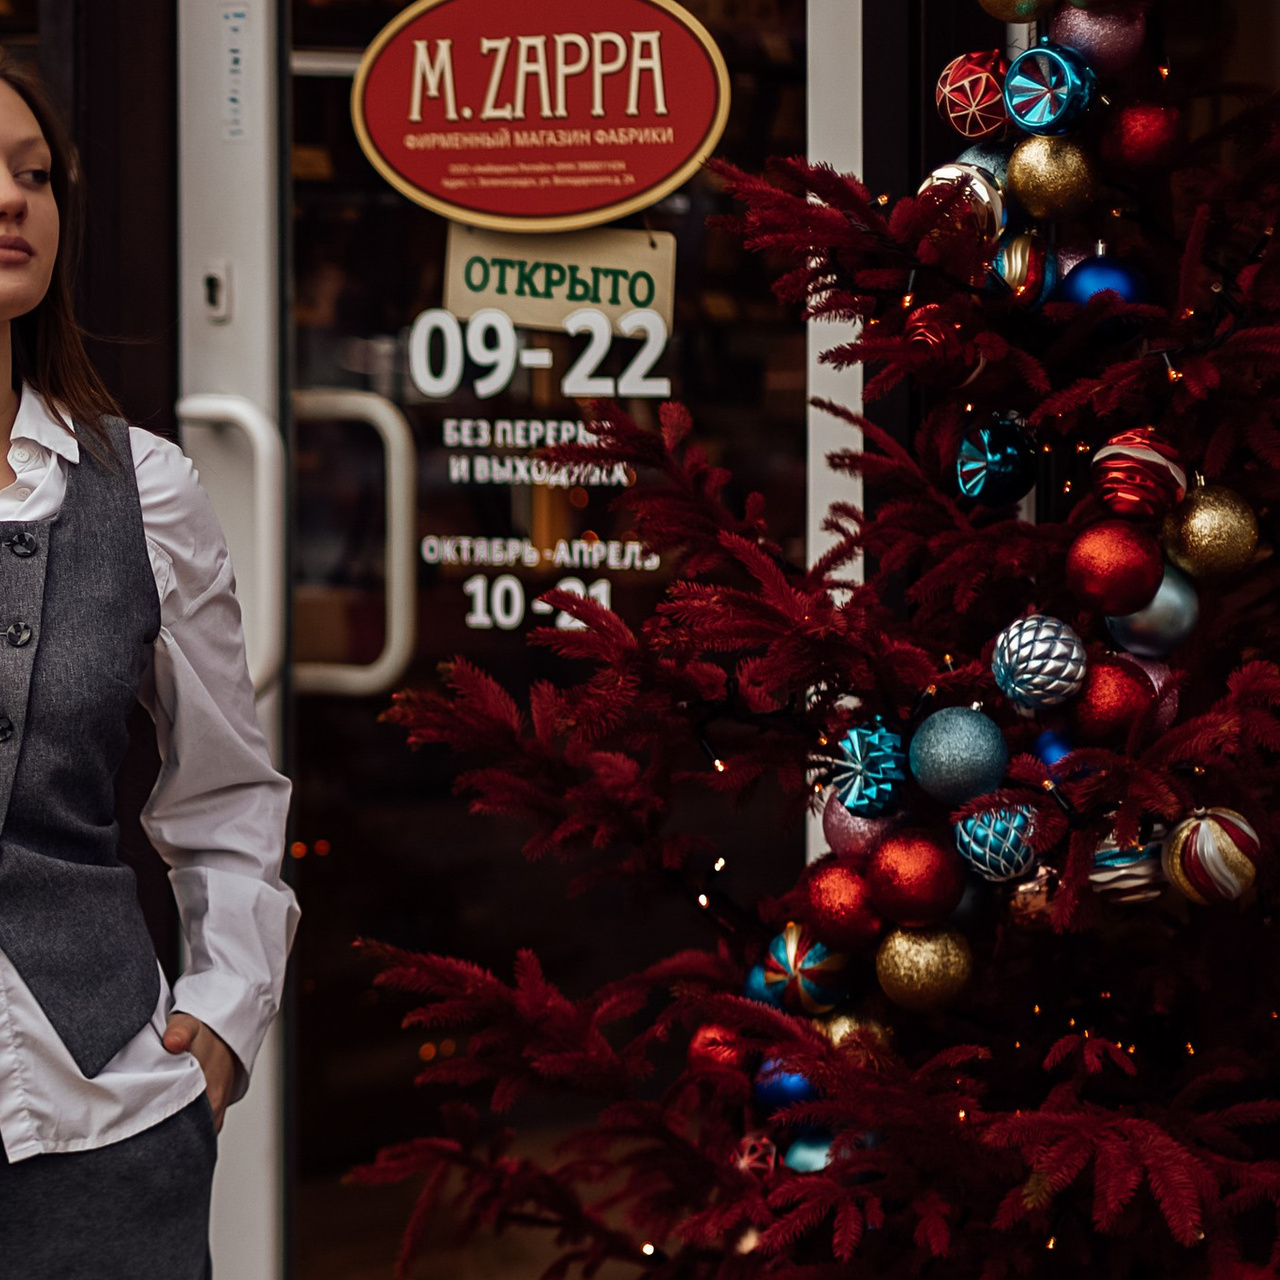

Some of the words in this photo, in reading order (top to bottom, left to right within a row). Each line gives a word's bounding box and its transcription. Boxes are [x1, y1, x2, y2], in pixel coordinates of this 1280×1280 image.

[408, 38, 472, 122] M.
[480, 30, 668, 121] ZAPPA
[403, 126, 511, 150] ФИРМЕННЫЙ
[512, 129, 592, 148] МАГАЗИН
[593, 126, 675, 147] ФАБРИКИ
[464, 256, 656, 308] ОТКРЫТО
[409, 308, 672, 399] 09-22
[443, 419, 492, 448] БЕЗ
[449, 455, 470, 483] И
